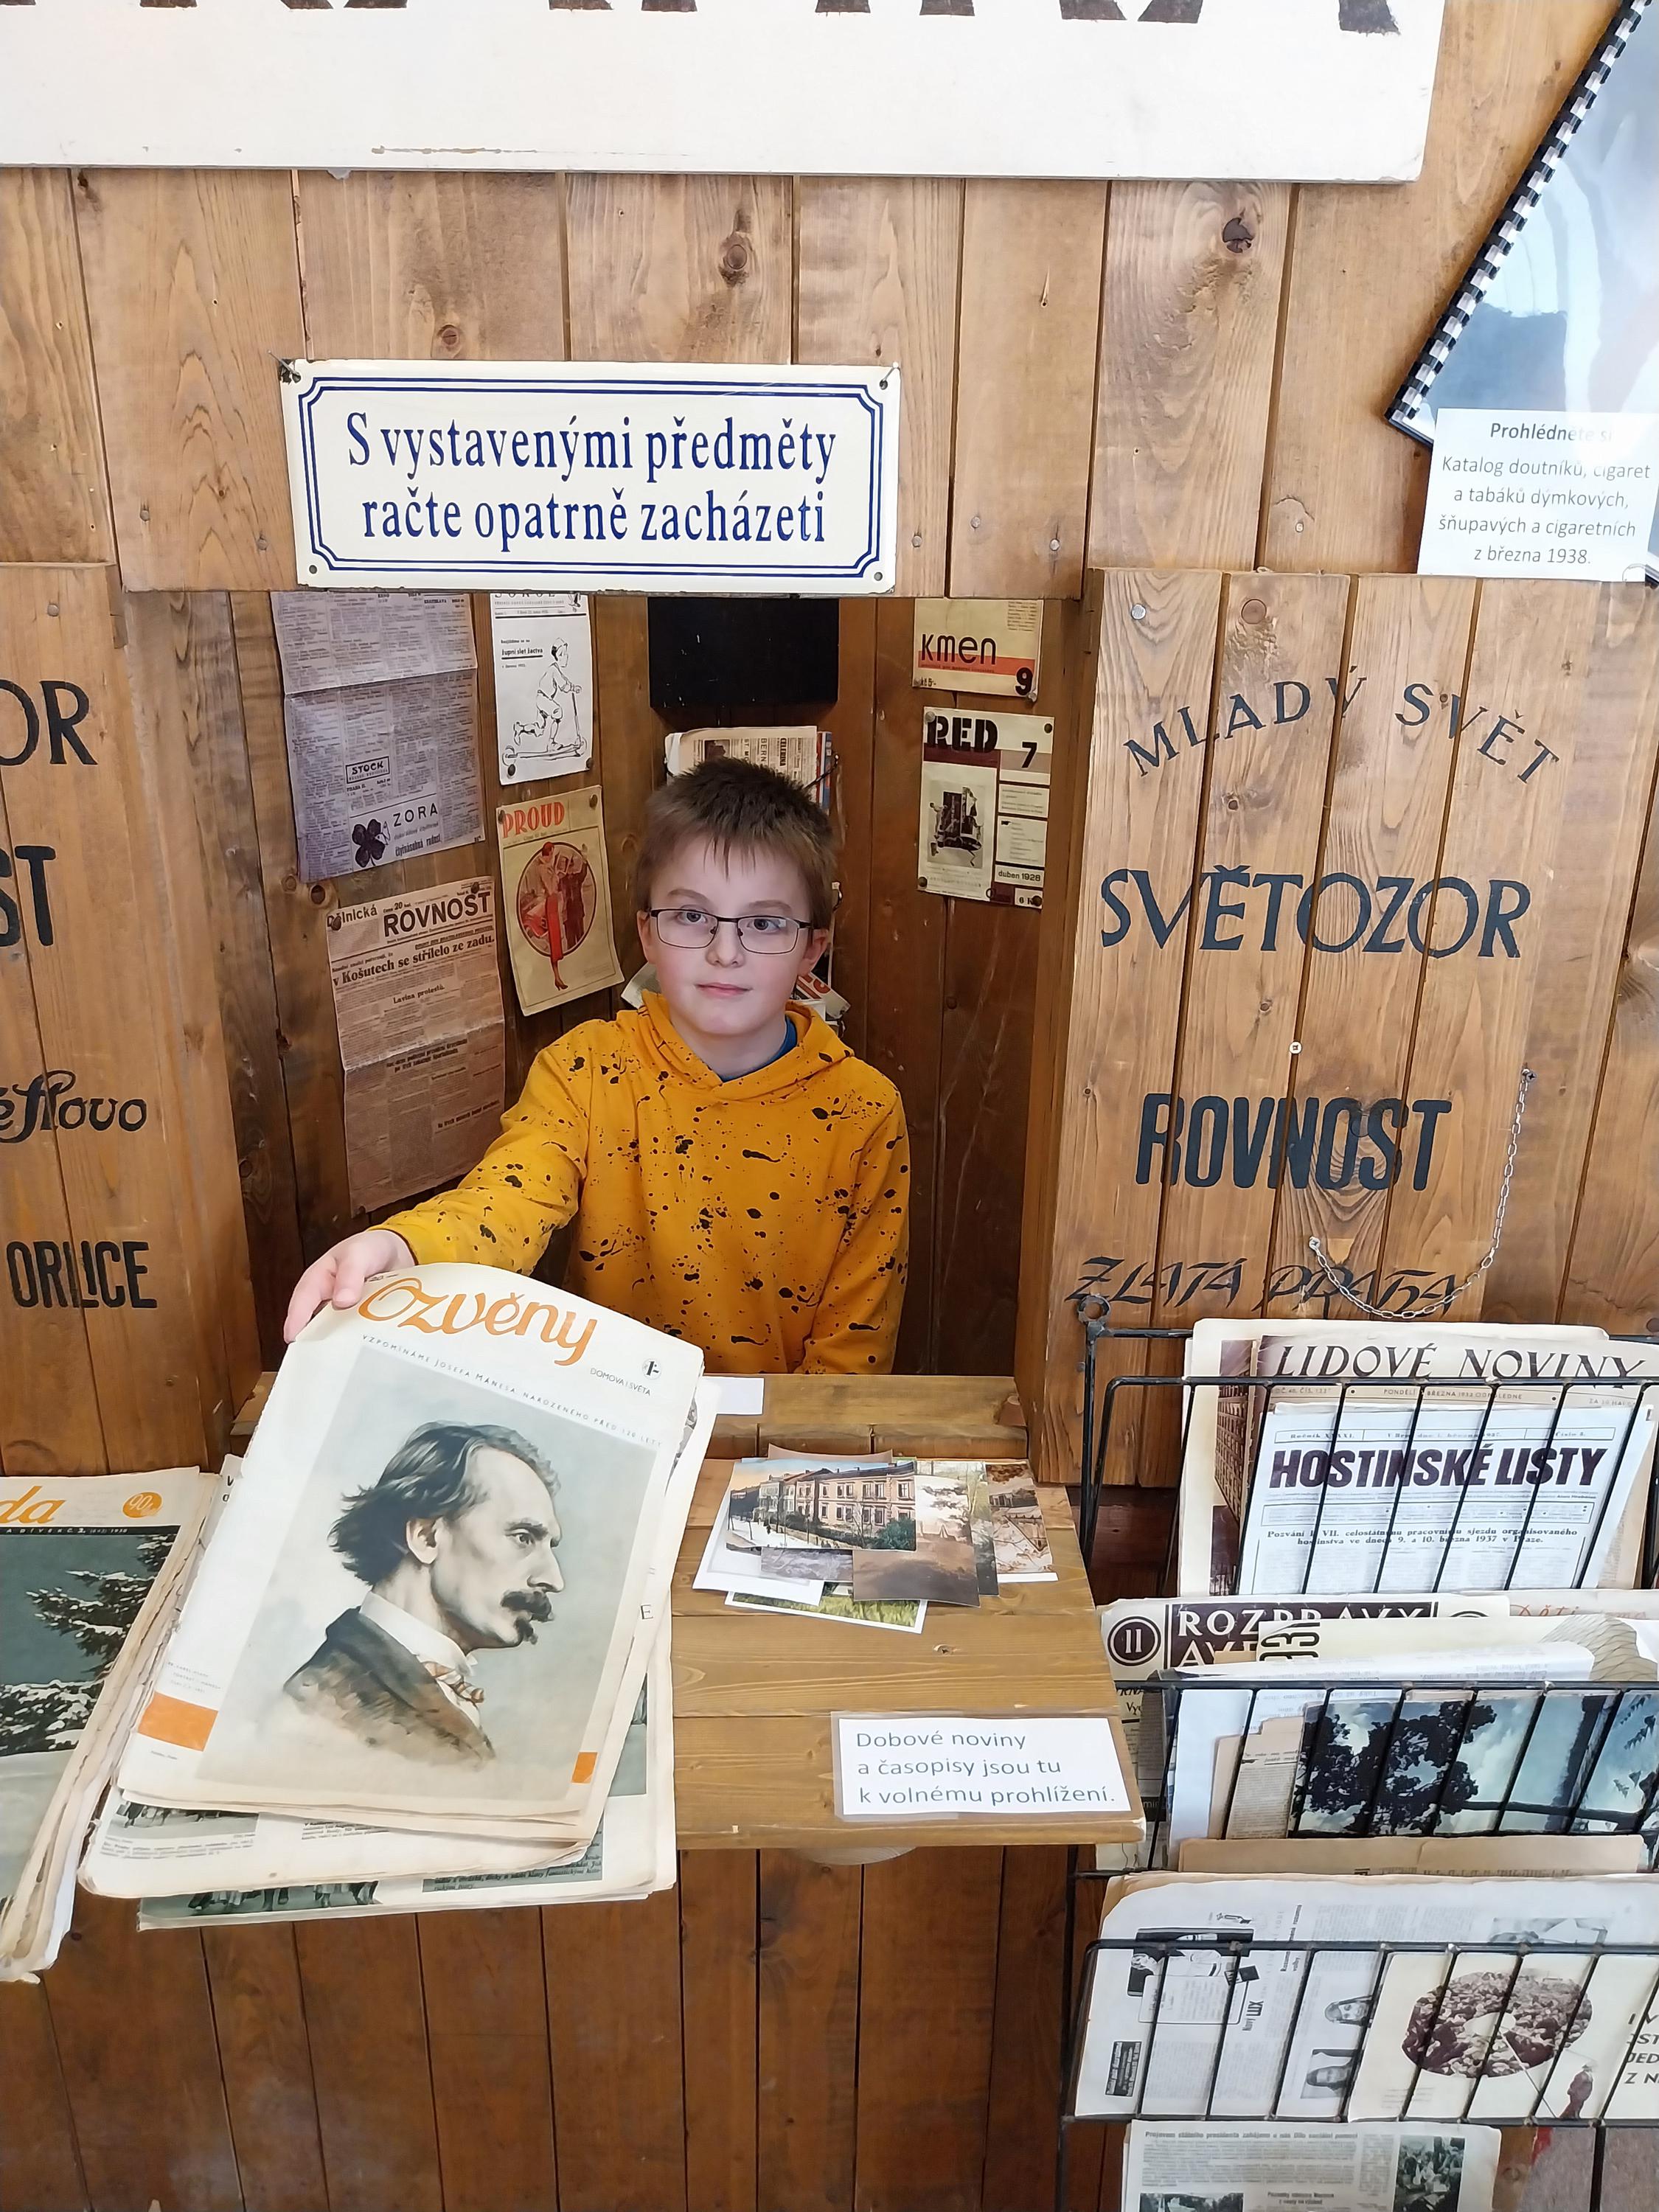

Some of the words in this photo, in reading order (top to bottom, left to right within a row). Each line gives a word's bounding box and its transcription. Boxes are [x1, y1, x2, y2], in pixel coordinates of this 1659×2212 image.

[348, 411, 369, 466] S
[381, 416, 634, 481] vystavenými
[646, 416, 837, 483] předměty
[1442, 456, 1503, 477] Katalog
[1509, 458, 1587, 478] doutníků,
[1593, 462, 1651, 481] cigaret
[1454, 490, 1462, 501] a
[1469, 487, 1525, 504] tabáků
[1531, 488, 1629, 509] dýmkových,
[362, 487, 462, 539] račte
[475, 487, 627, 552] opatrně
[641, 490, 826, 543] zacházeti
[1439, 515, 1526, 537] šňupavých
[1531, 522, 1540, 532] a
[1545, 520, 1636, 538] cigaretních
[1474, 549, 1481, 560] z
[1487, 546, 1541, 563] března
[1547, 548, 1592, 565] 1938.
[1015, 667, 1034, 696] 9
[925, 715, 998, 754] RED
[1123, 666, 1367, 776] MLADÝ
[1395, 682, 1559, 785] SVĚT
[1021, 741, 1037, 768] 7
[352, 761, 384, 775] STOCK
[393, 803, 438, 827] ZORA
[503, 801, 565, 838] PROUD
[998, 870, 1020, 880] duben
[1021, 873, 1041, 882] 1928
[327, 904, 378, 928] Dlnická
[394, 902, 403, 911] 20
[383, 891, 491, 937] ROVNOST
[1100, 864, 1531, 959] SVĚTOZOR
[333, 978, 339, 987] v
[341, 961, 394, 984] Košutech
[398, 957, 410, 967] se
[412, 946, 450, 963] střílelo
[452, 942, 465, 953] ze
[467, 933, 495, 949] zadu.
[393, 993, 415, 1004] Lavina
[1135, 1092, 1452, 1192] ROVNOST
[6, 1240, 158, 1309] ORLICE
[1064, 1256, 1248, 1310] ZLATÁ
[1252, 1264, 1460, 1312] PRAHA
[358, 1278, 598, 1366] Ozvěny
[362, 1335, 431, 1363] VZPOMÍNÁME
[434, 1359, 470, 1377] JOSEFA
[523, 1391, 589, 1420] NAROZENÉHO
[1274, 1343, 1438, 1378] LIDOVÉ
[1458, 1349, 1646, 1389] NOVINY
[590, 1367, 625, 1387] DOMOVA
[630, 1382, 651, 1397] SVĚTA
[1475, 1391, 1523, 1399] ODPLEDNE
[1269, 1443, 1494, 1489] HOSTINSKÉ
[1494, 1447, 1608, 1486] LISTY
[1267, 1530, 1305, 1538] Pozvání
[1345, 1528, 1402, 1537] celostátnmu
[1467, 1528, 1497, 1537] sjezdu
[1298, 1537, 1343, 1545] hosinstva
[856, 1730, 943, 1747] Dobové
[952, 1733, 1026, 1750] noviny
[858, 1762, 869, 1775] a
[878, 1758, 975, 1777] časopisy
[982, 1759, 1030, 1777] jsou
[1037, 1759, 1061, 1773] tu
[860, 1787, 872, 1804] k
[879, 1785, 981, 1804] volnému
[992, 1785, 1116, 1806] prohlížení.
[1246, 2000, 1264, 2017] LUX
[1627, 2034, 1659, 2045] ST
[1644, 2073, 1659, 2084] N
